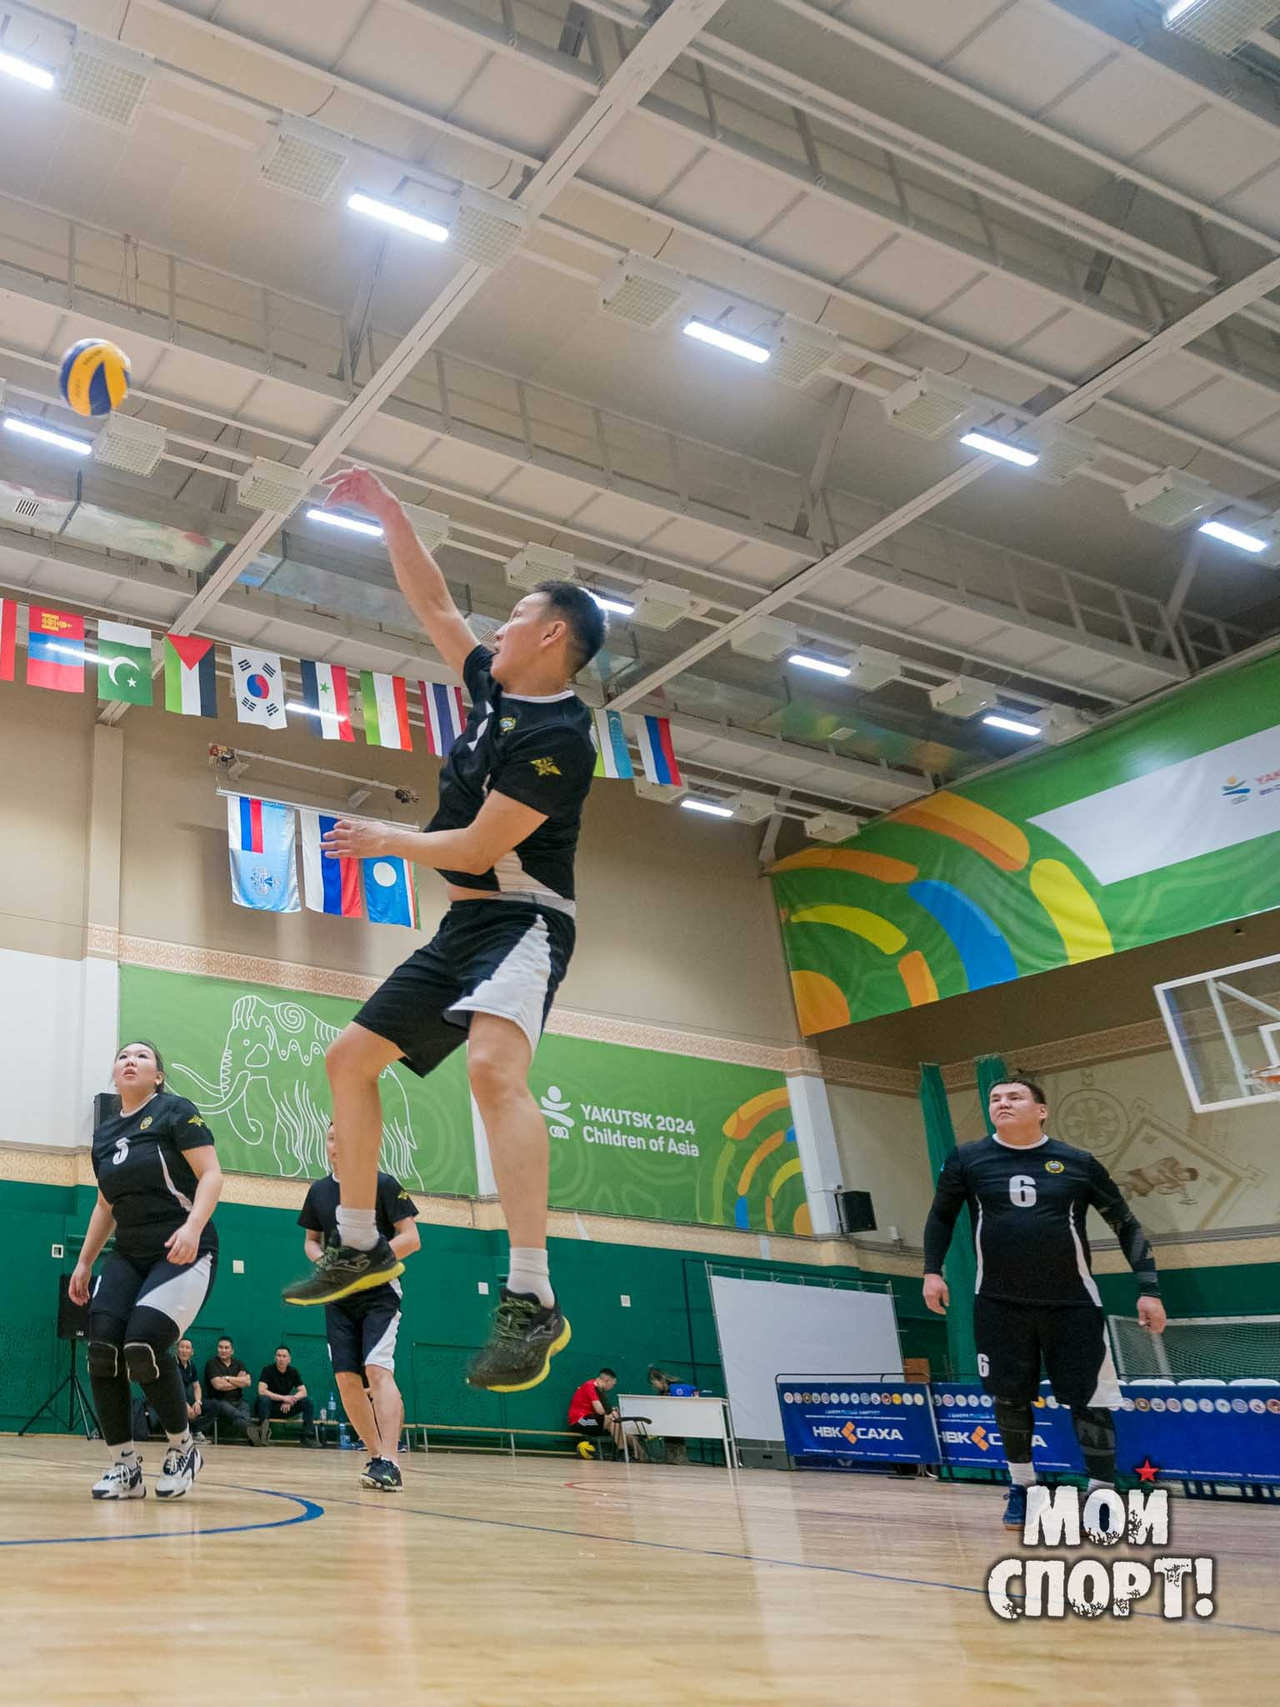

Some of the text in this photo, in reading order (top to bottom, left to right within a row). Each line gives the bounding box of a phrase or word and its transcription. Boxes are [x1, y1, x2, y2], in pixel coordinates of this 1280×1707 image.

[580, 1104, 696, 1135] YAKUTSK 2024
[583, 1126, 700, 1157] Children of Asia
[1009, 1175, 1037, 1207] 6
[977, 1353, 990, 1377] 6
[812, 1426, 904, 1441] НВК САХА
